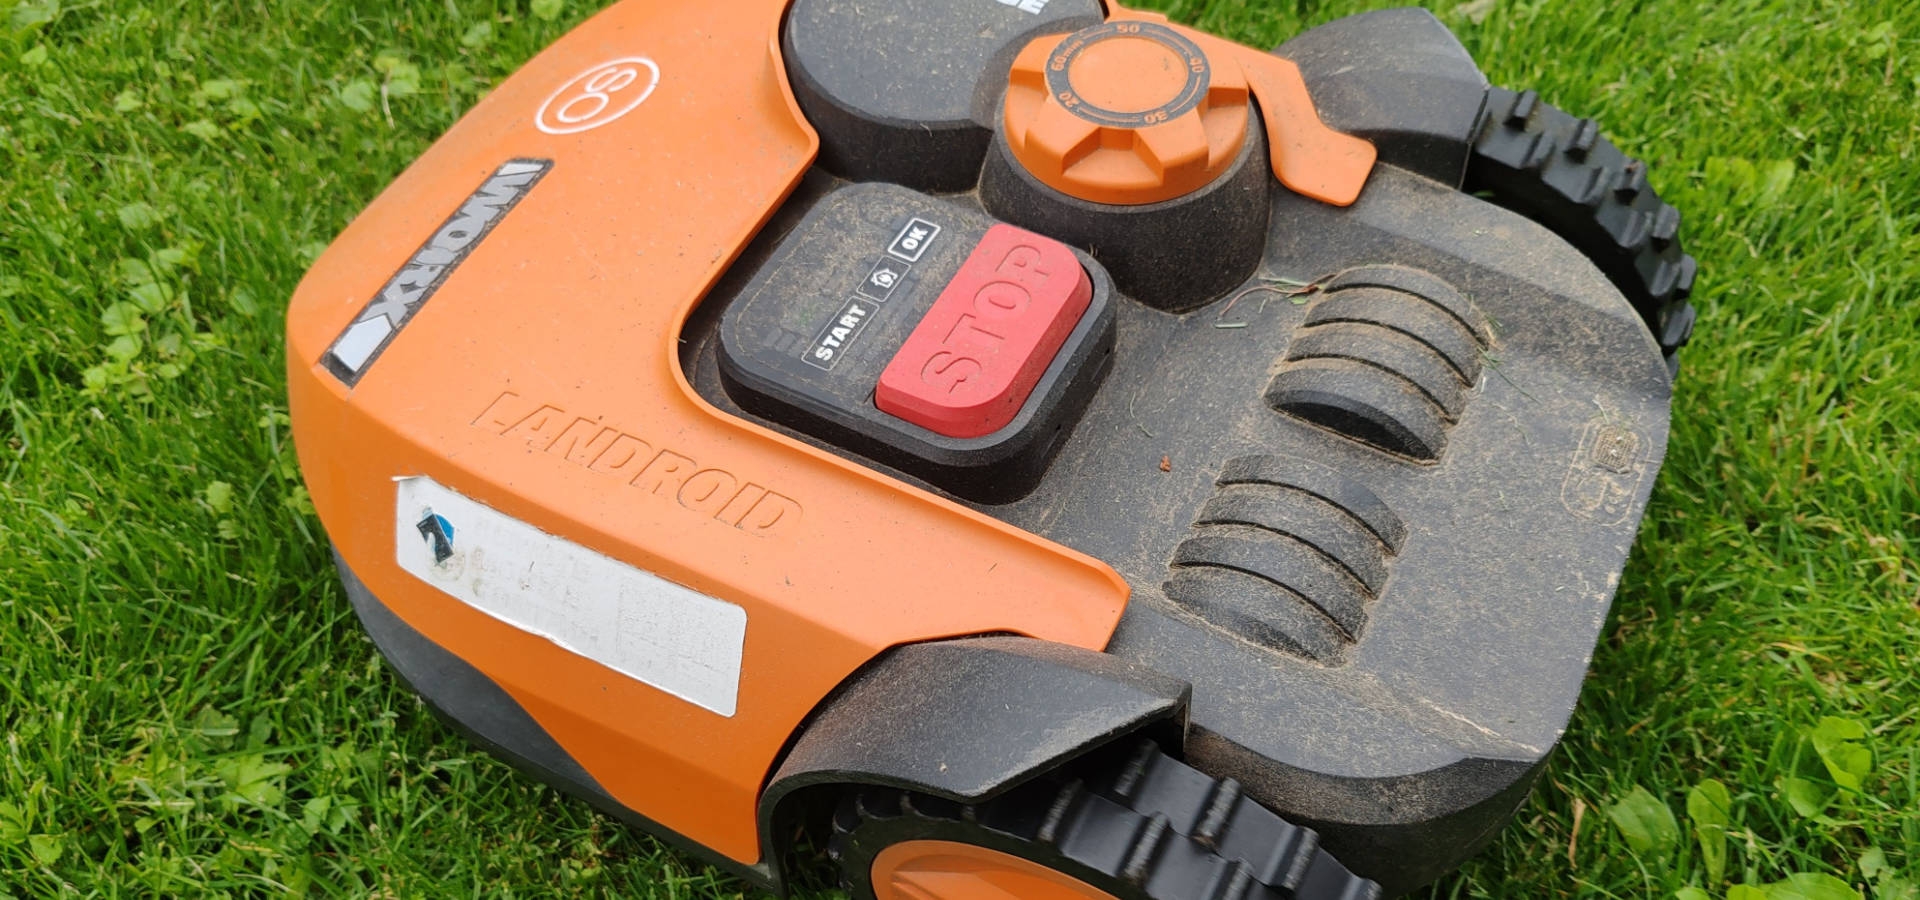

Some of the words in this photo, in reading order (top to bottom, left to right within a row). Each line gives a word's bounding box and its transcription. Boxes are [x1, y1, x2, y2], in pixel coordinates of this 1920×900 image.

[1116, 24, 1140, 35] 50
[1189, 57, 1205, 73] 40
[1058, 92, 1080, 109] 20
[1144, 109, 1168, 124] 30
[358, 169, 541, 328] WORX
[901, 226, 929, 250] OK
[920, 244, 1050, 395] STOP
[815, 304, 868, 361] START
[470, 391, 803, 539] LANDROID
